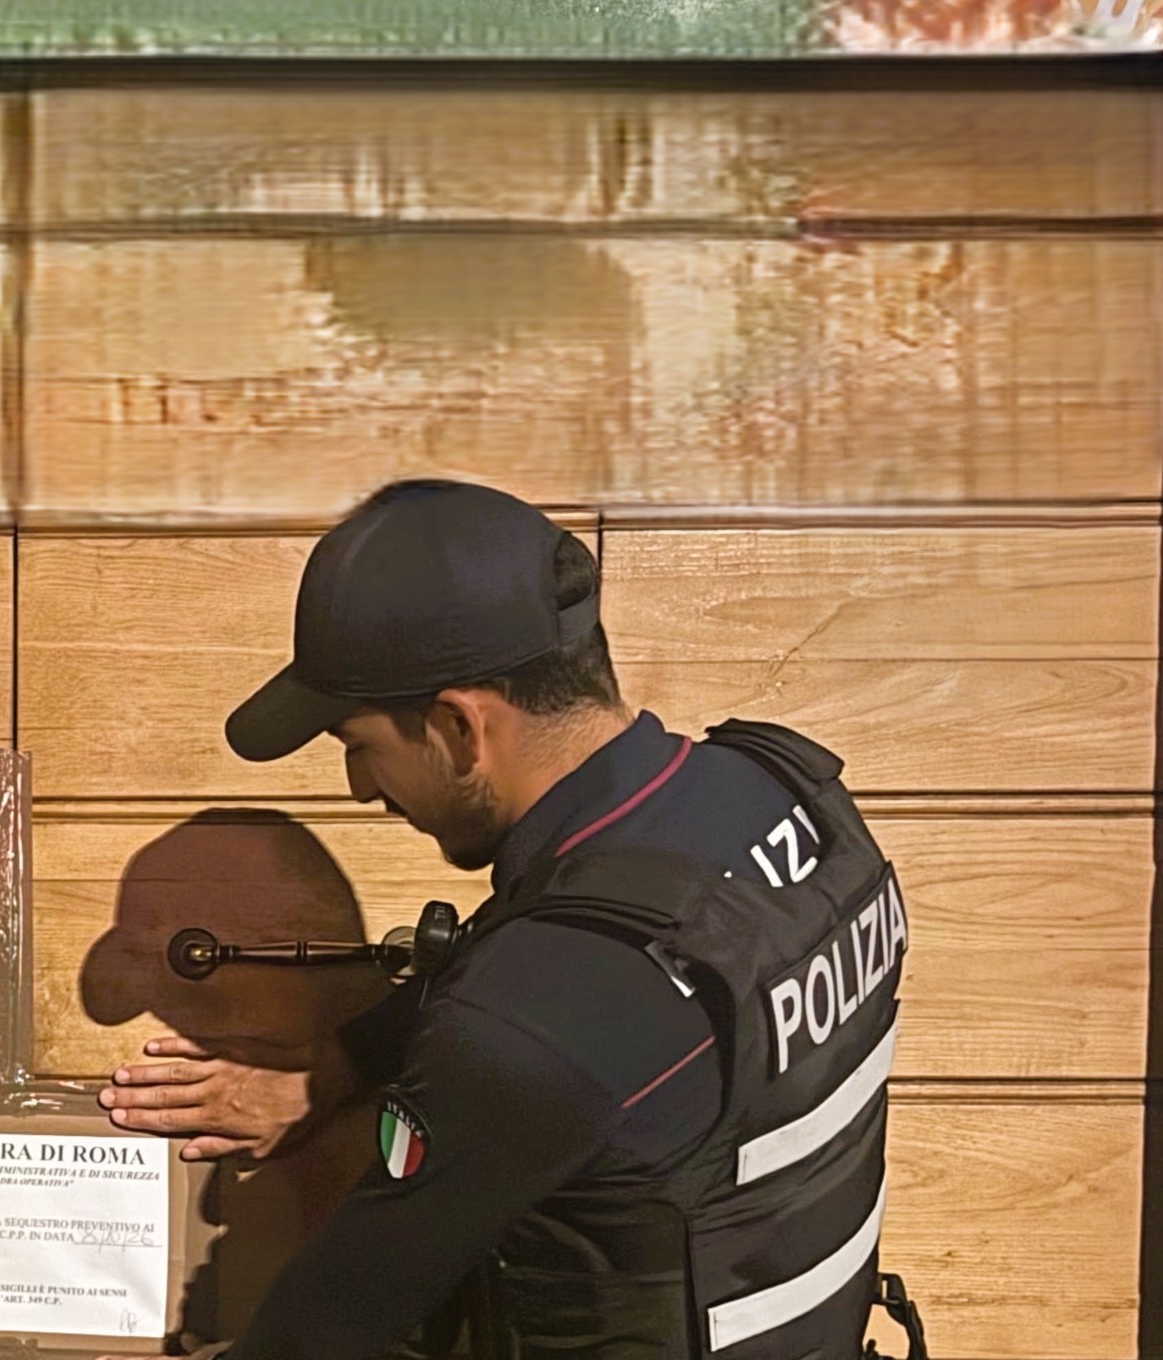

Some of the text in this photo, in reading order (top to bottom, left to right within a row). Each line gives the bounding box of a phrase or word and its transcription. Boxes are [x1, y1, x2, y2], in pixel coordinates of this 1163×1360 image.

[769, 877, 908, 1075] POLIZIA
[39, 1143, 65, 1162] DI
[72, 1145, 145, 1166] ROMA
[78, 1169, 87, 1178] E
[88, 1170, 101, 1179] DI
[102, 1170, 160, 1181] SICUREZZA
[4, 1217, 69, 1229] SEQUESTRO
[70, 1220, 141, 1232] PREVENTIVO
[143, 1223, 155, 1233] AI
[29, 1231, 41, 1241] IN
[43, 1232, 74, 1243] DATA
[0, 1283, 37, 1293] SIGILLI
[48, 1285, 85, 1296] PUNITO
[86, 1288, 98, 1297] AI
[99, 1288, 127, 1298] SENSI
[27, 1295, 43, 1304] 349
[44, 1295, 63, 1306] C.P.
